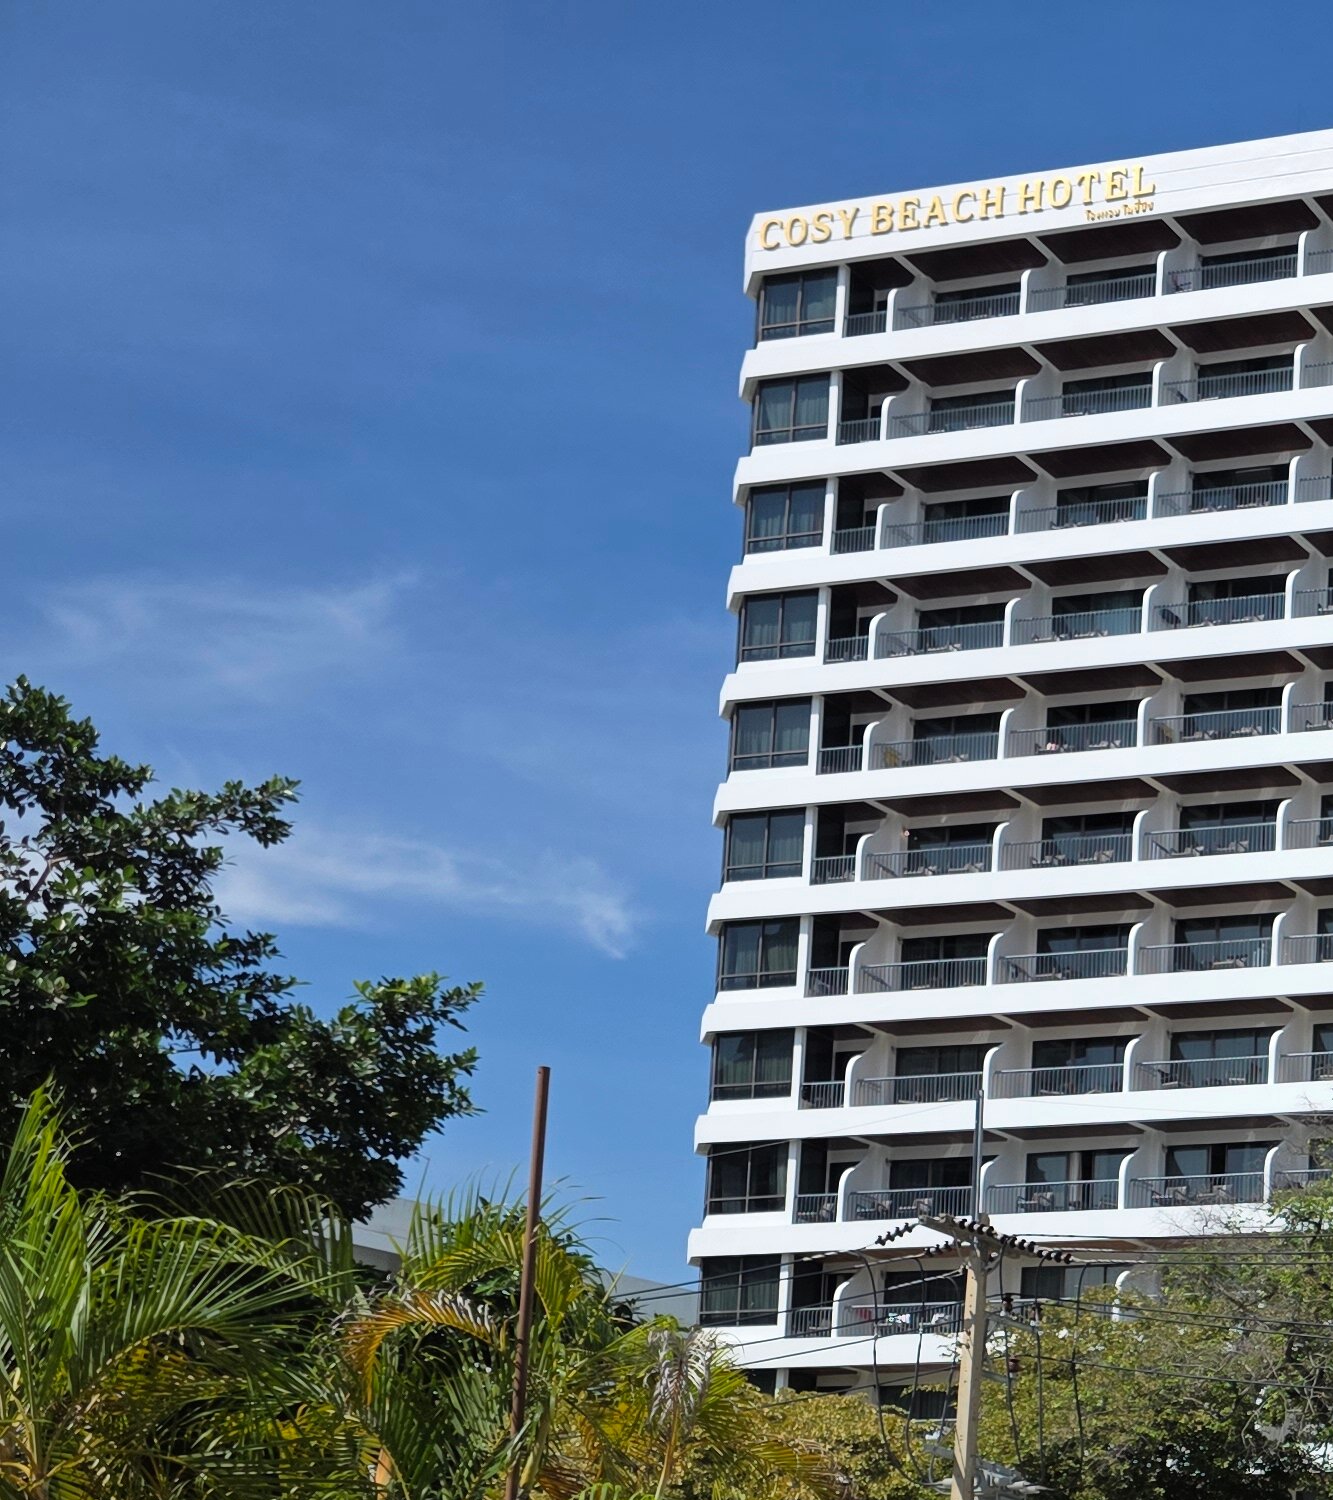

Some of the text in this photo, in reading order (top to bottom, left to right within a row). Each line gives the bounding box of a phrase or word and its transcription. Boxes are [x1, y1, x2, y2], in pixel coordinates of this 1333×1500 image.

[759, 165, 1156, 250] COSY BEACH HOTEL
